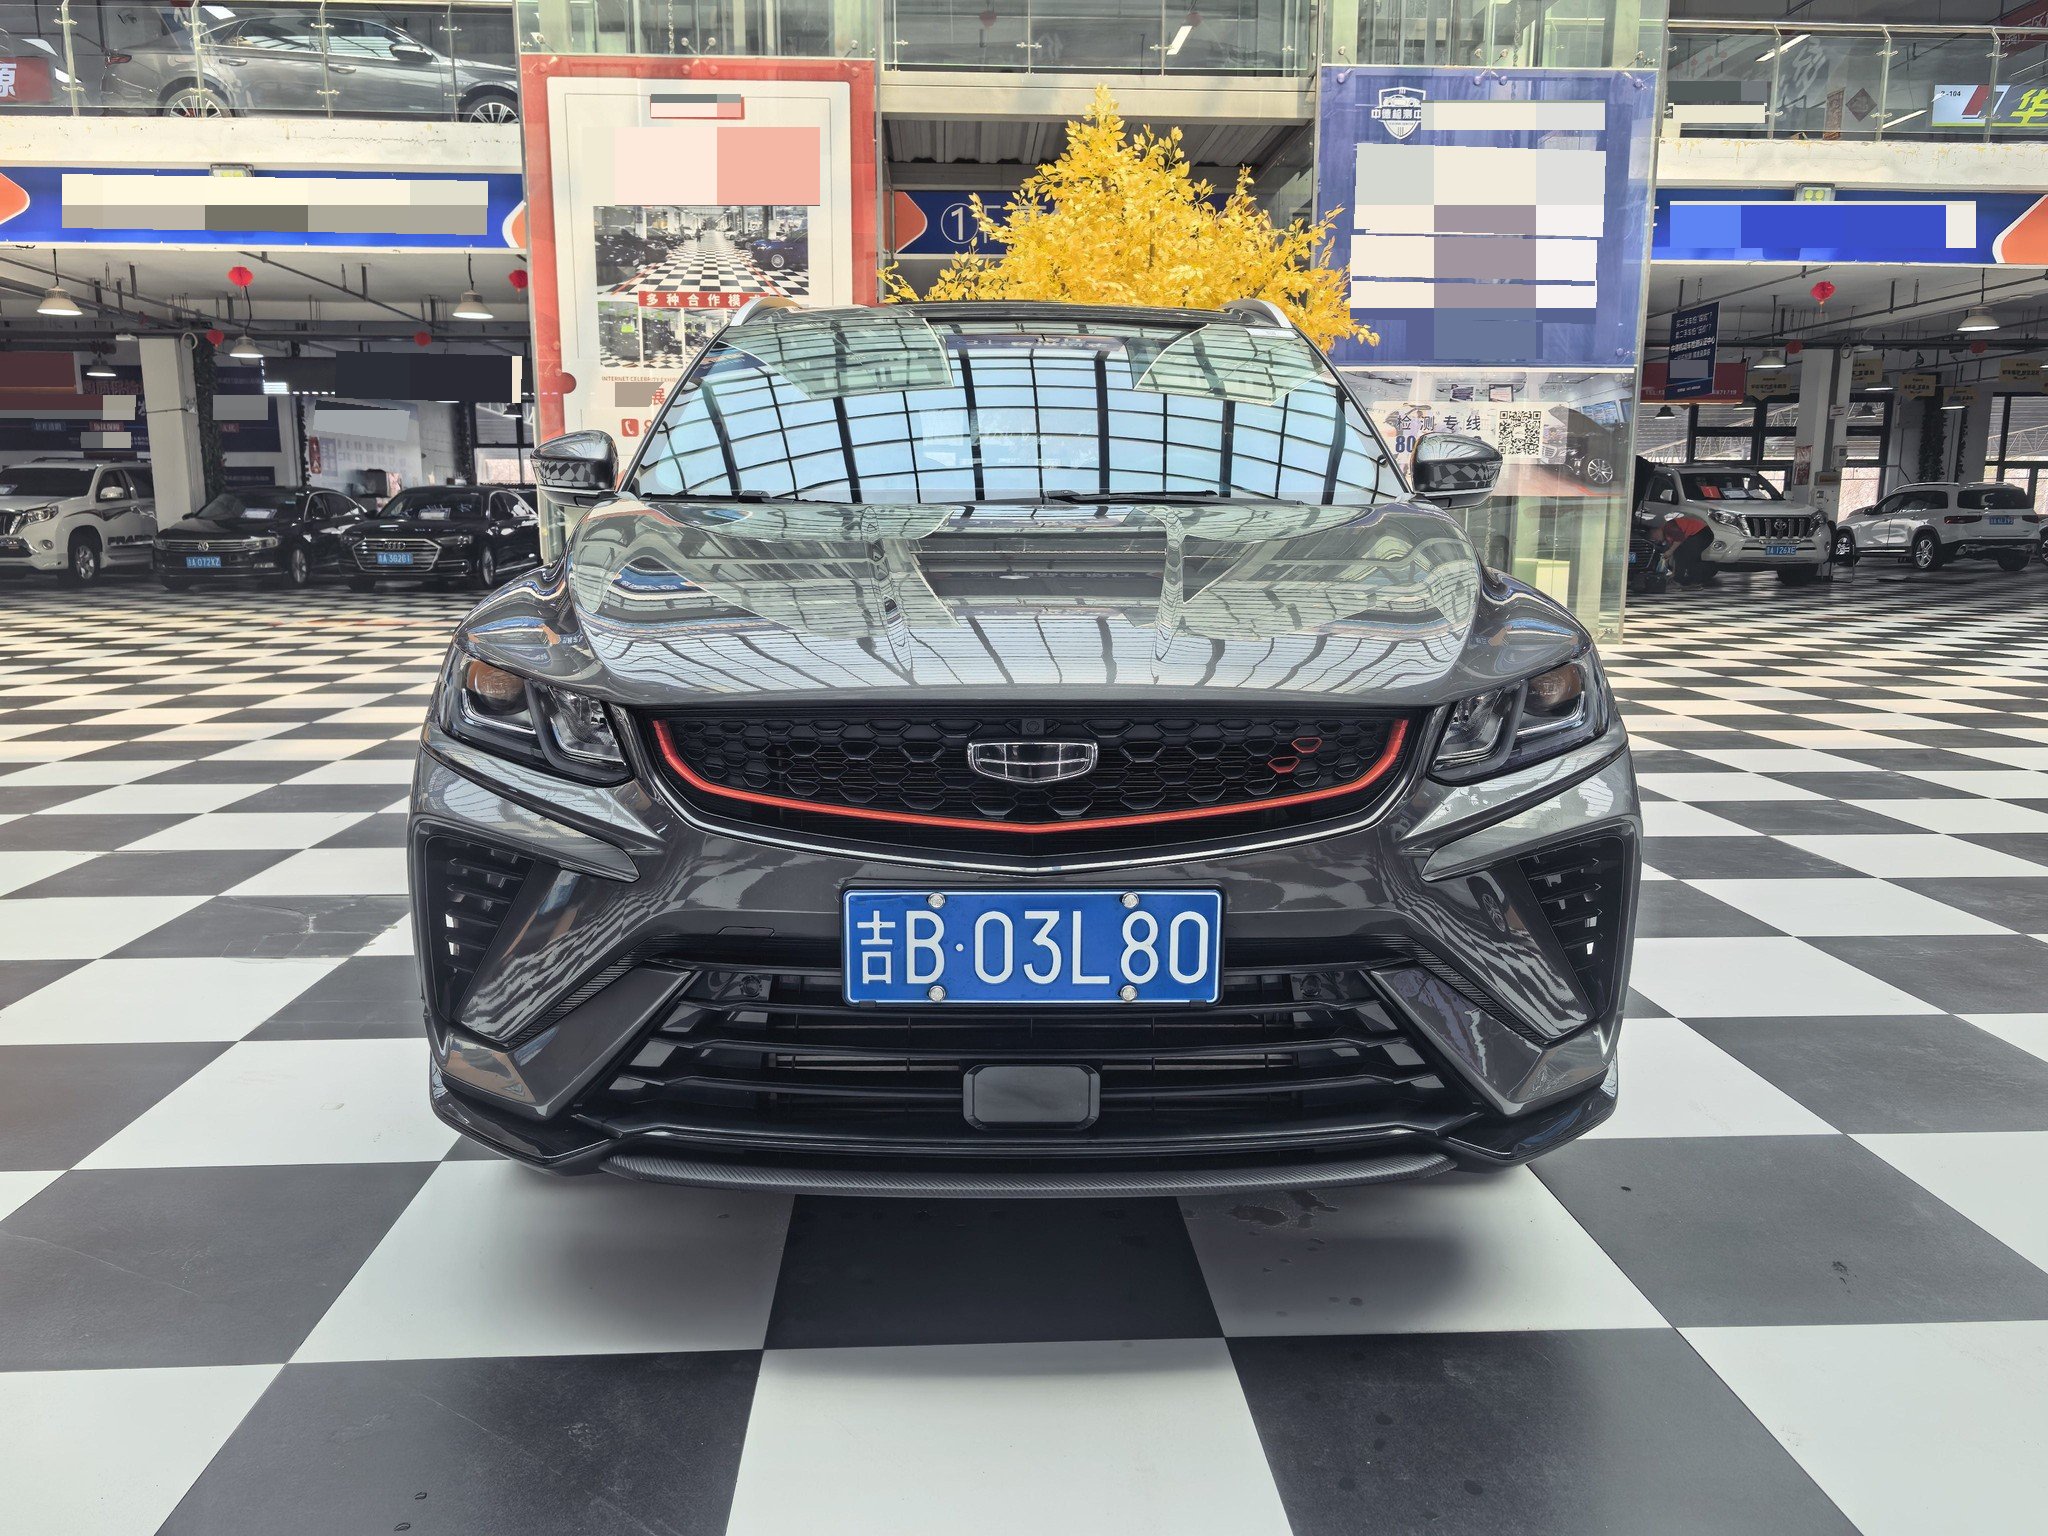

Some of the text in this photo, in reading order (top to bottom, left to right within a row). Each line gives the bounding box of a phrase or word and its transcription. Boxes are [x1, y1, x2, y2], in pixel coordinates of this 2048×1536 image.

[646, 292, 762, 307] 多种合作模
[1397, 415, 1481, 431] 检测专线
[857, 910, 1209, 984] 吉B·03L80
